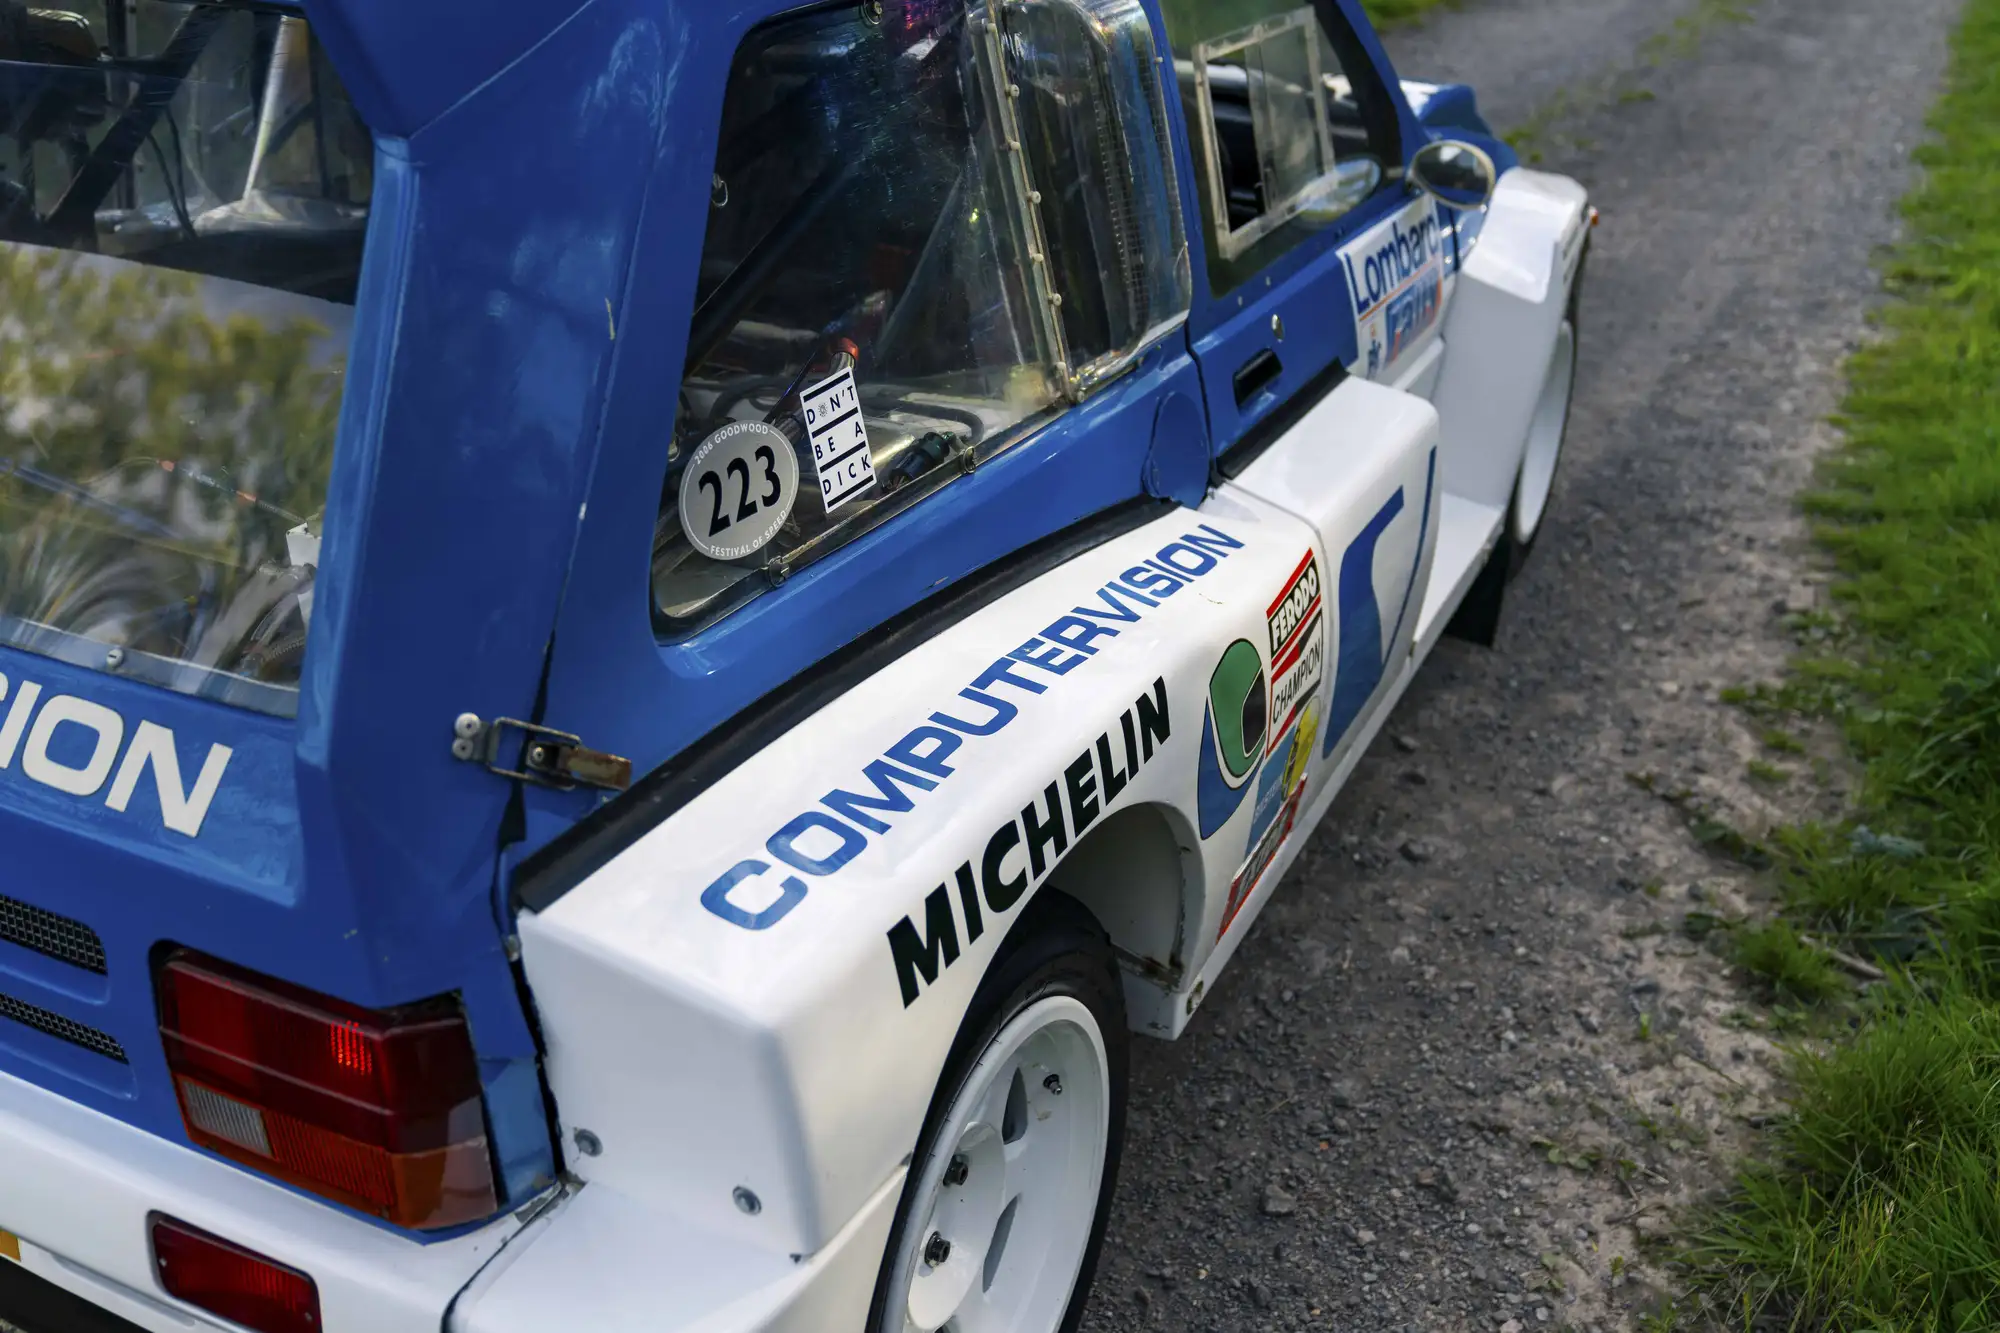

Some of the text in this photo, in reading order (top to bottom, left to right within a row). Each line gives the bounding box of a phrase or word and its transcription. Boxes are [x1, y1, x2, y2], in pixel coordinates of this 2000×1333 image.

[694, 423, 769, 465] 2006 GOODWOOD
[815, 421, 864, 460] BE A
[822, 454, 871, 495] DICK
[698, 445, 781, 537] 223
[710, 510, 787, 557] FESTIVAL OF SPEED
[1271, 566, 1317, 651] FERODO
[1272, 637, 1321, 724] CHAMPION
[0, 671, 233, 838] ION
[700, 524, 1246, 930] COMPUTERVISION
[886, 676, 1171, 1009] MICHELIN
